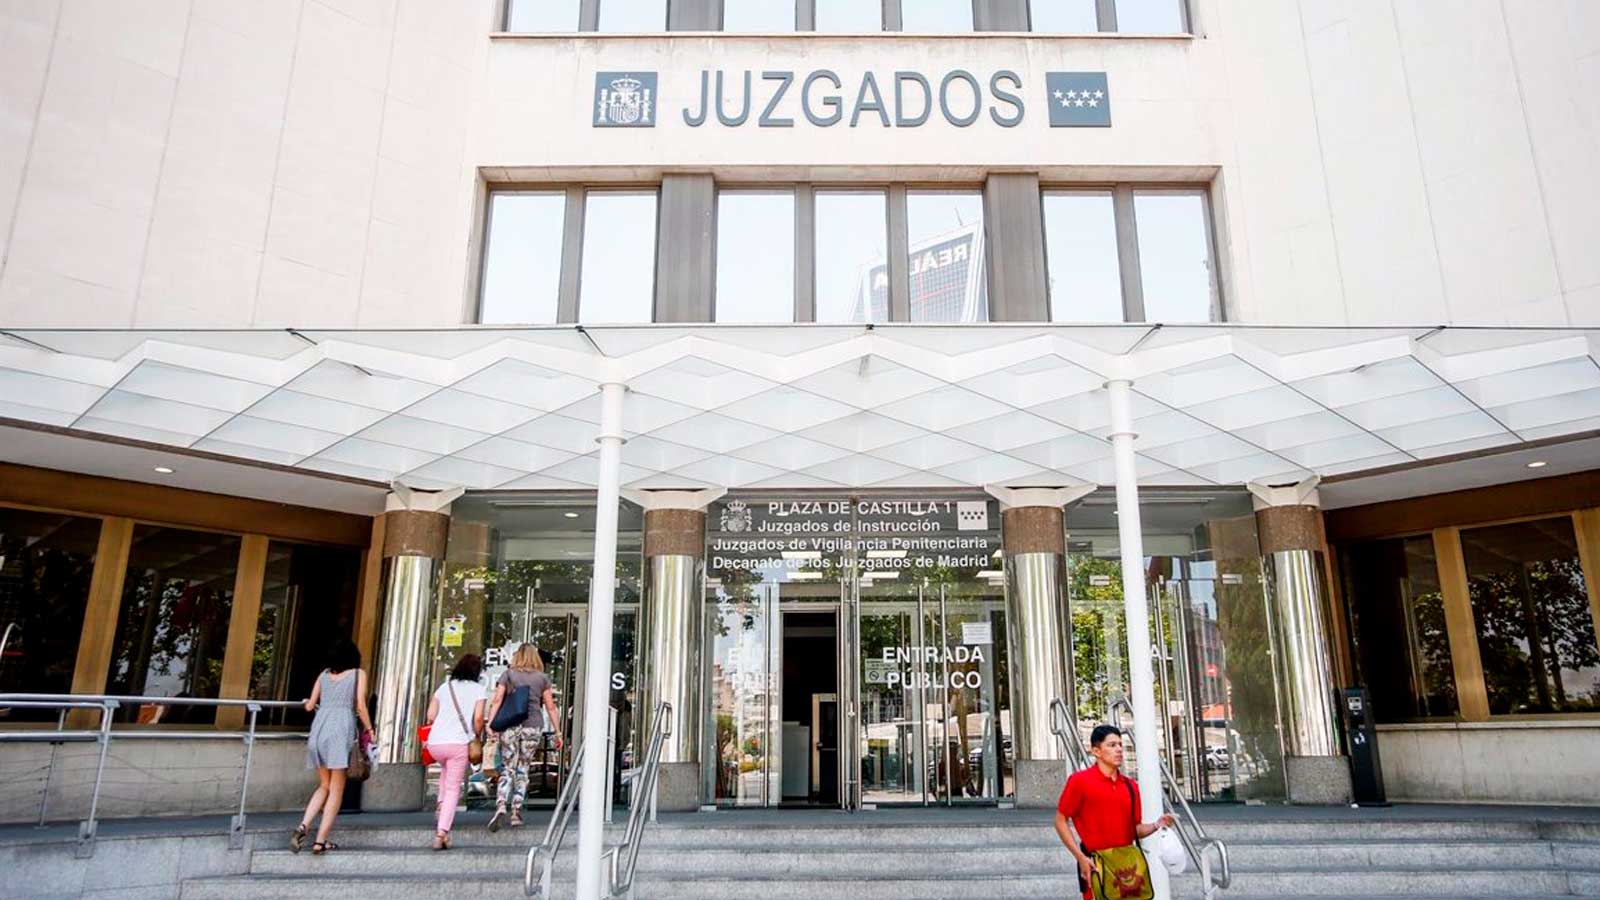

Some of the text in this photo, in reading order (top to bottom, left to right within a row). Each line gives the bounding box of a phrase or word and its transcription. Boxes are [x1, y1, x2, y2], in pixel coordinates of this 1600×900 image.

[682, 69, 1025, 129] JUZGADOS
[768, 501, 951, 515] PLAZA DE CASTILLA 1
[758, 519, 940, 535] Juzgados de Instrucción
[713, 536, 988, 553] Juzgados de Vigilancia Penitenciaria
[713, 554, 988, 571] Decanato de los Juzgados de Madrid
[882, 645, 985, 663] ENTRADA
[886, 667, 982, 689] PÚBLICO
